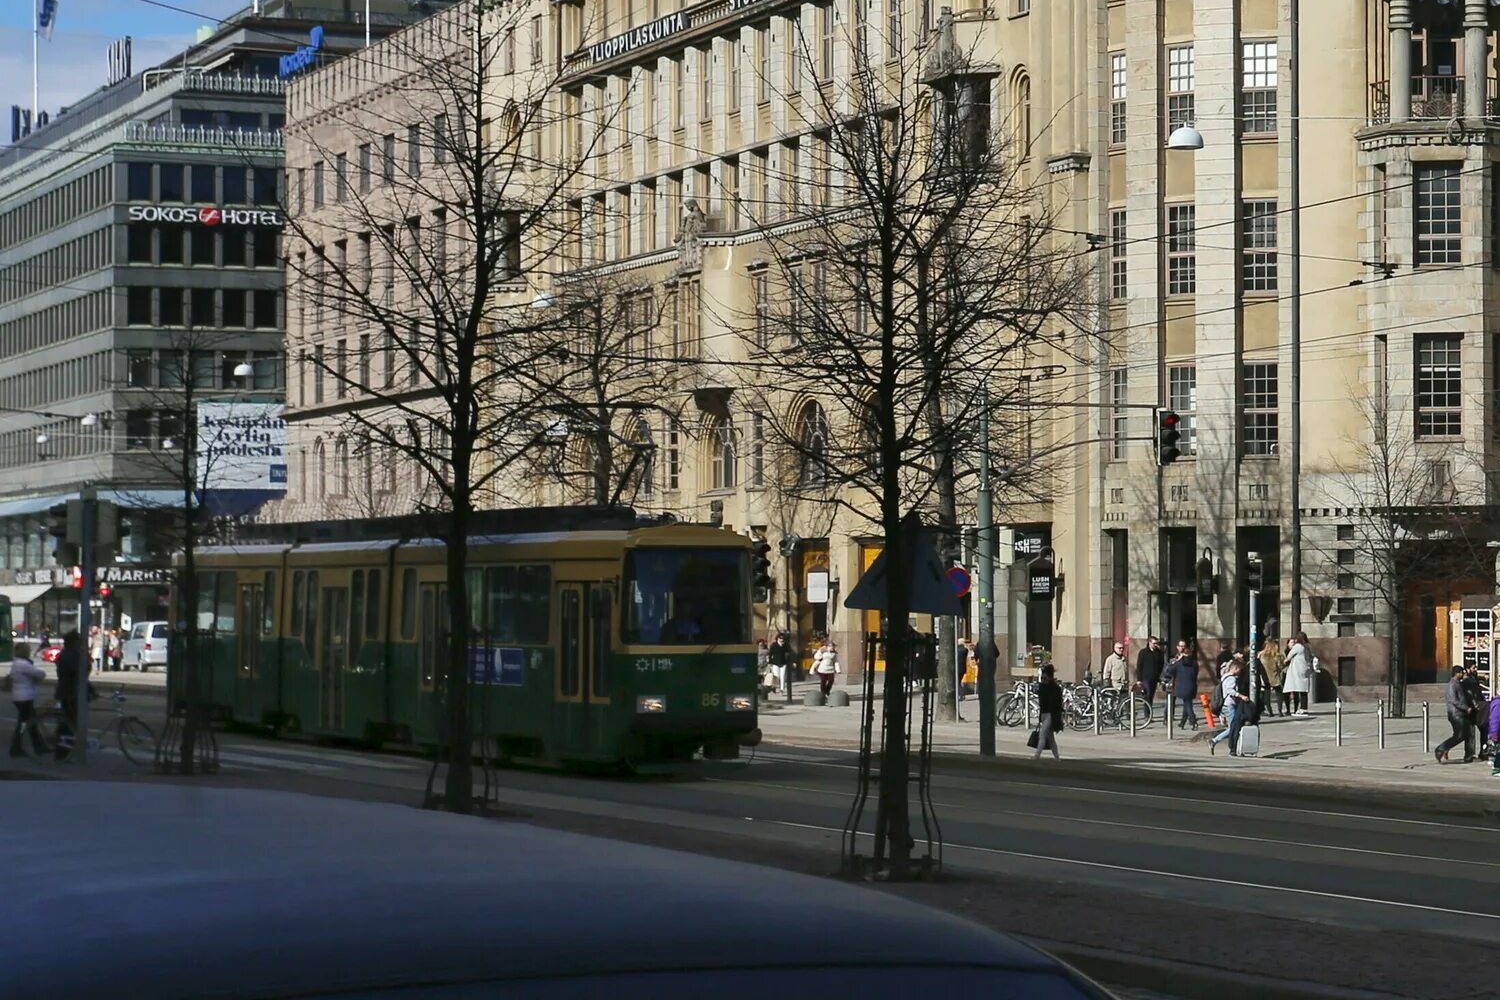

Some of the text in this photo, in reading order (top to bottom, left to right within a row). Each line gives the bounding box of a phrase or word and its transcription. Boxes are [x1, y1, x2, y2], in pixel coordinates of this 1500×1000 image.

[588, 12, 684, 63] YLIOPPILASKUNTA
[128, 205, 283, 226] SOKOS HOTEL
[702, 692, 720, 708] 86
